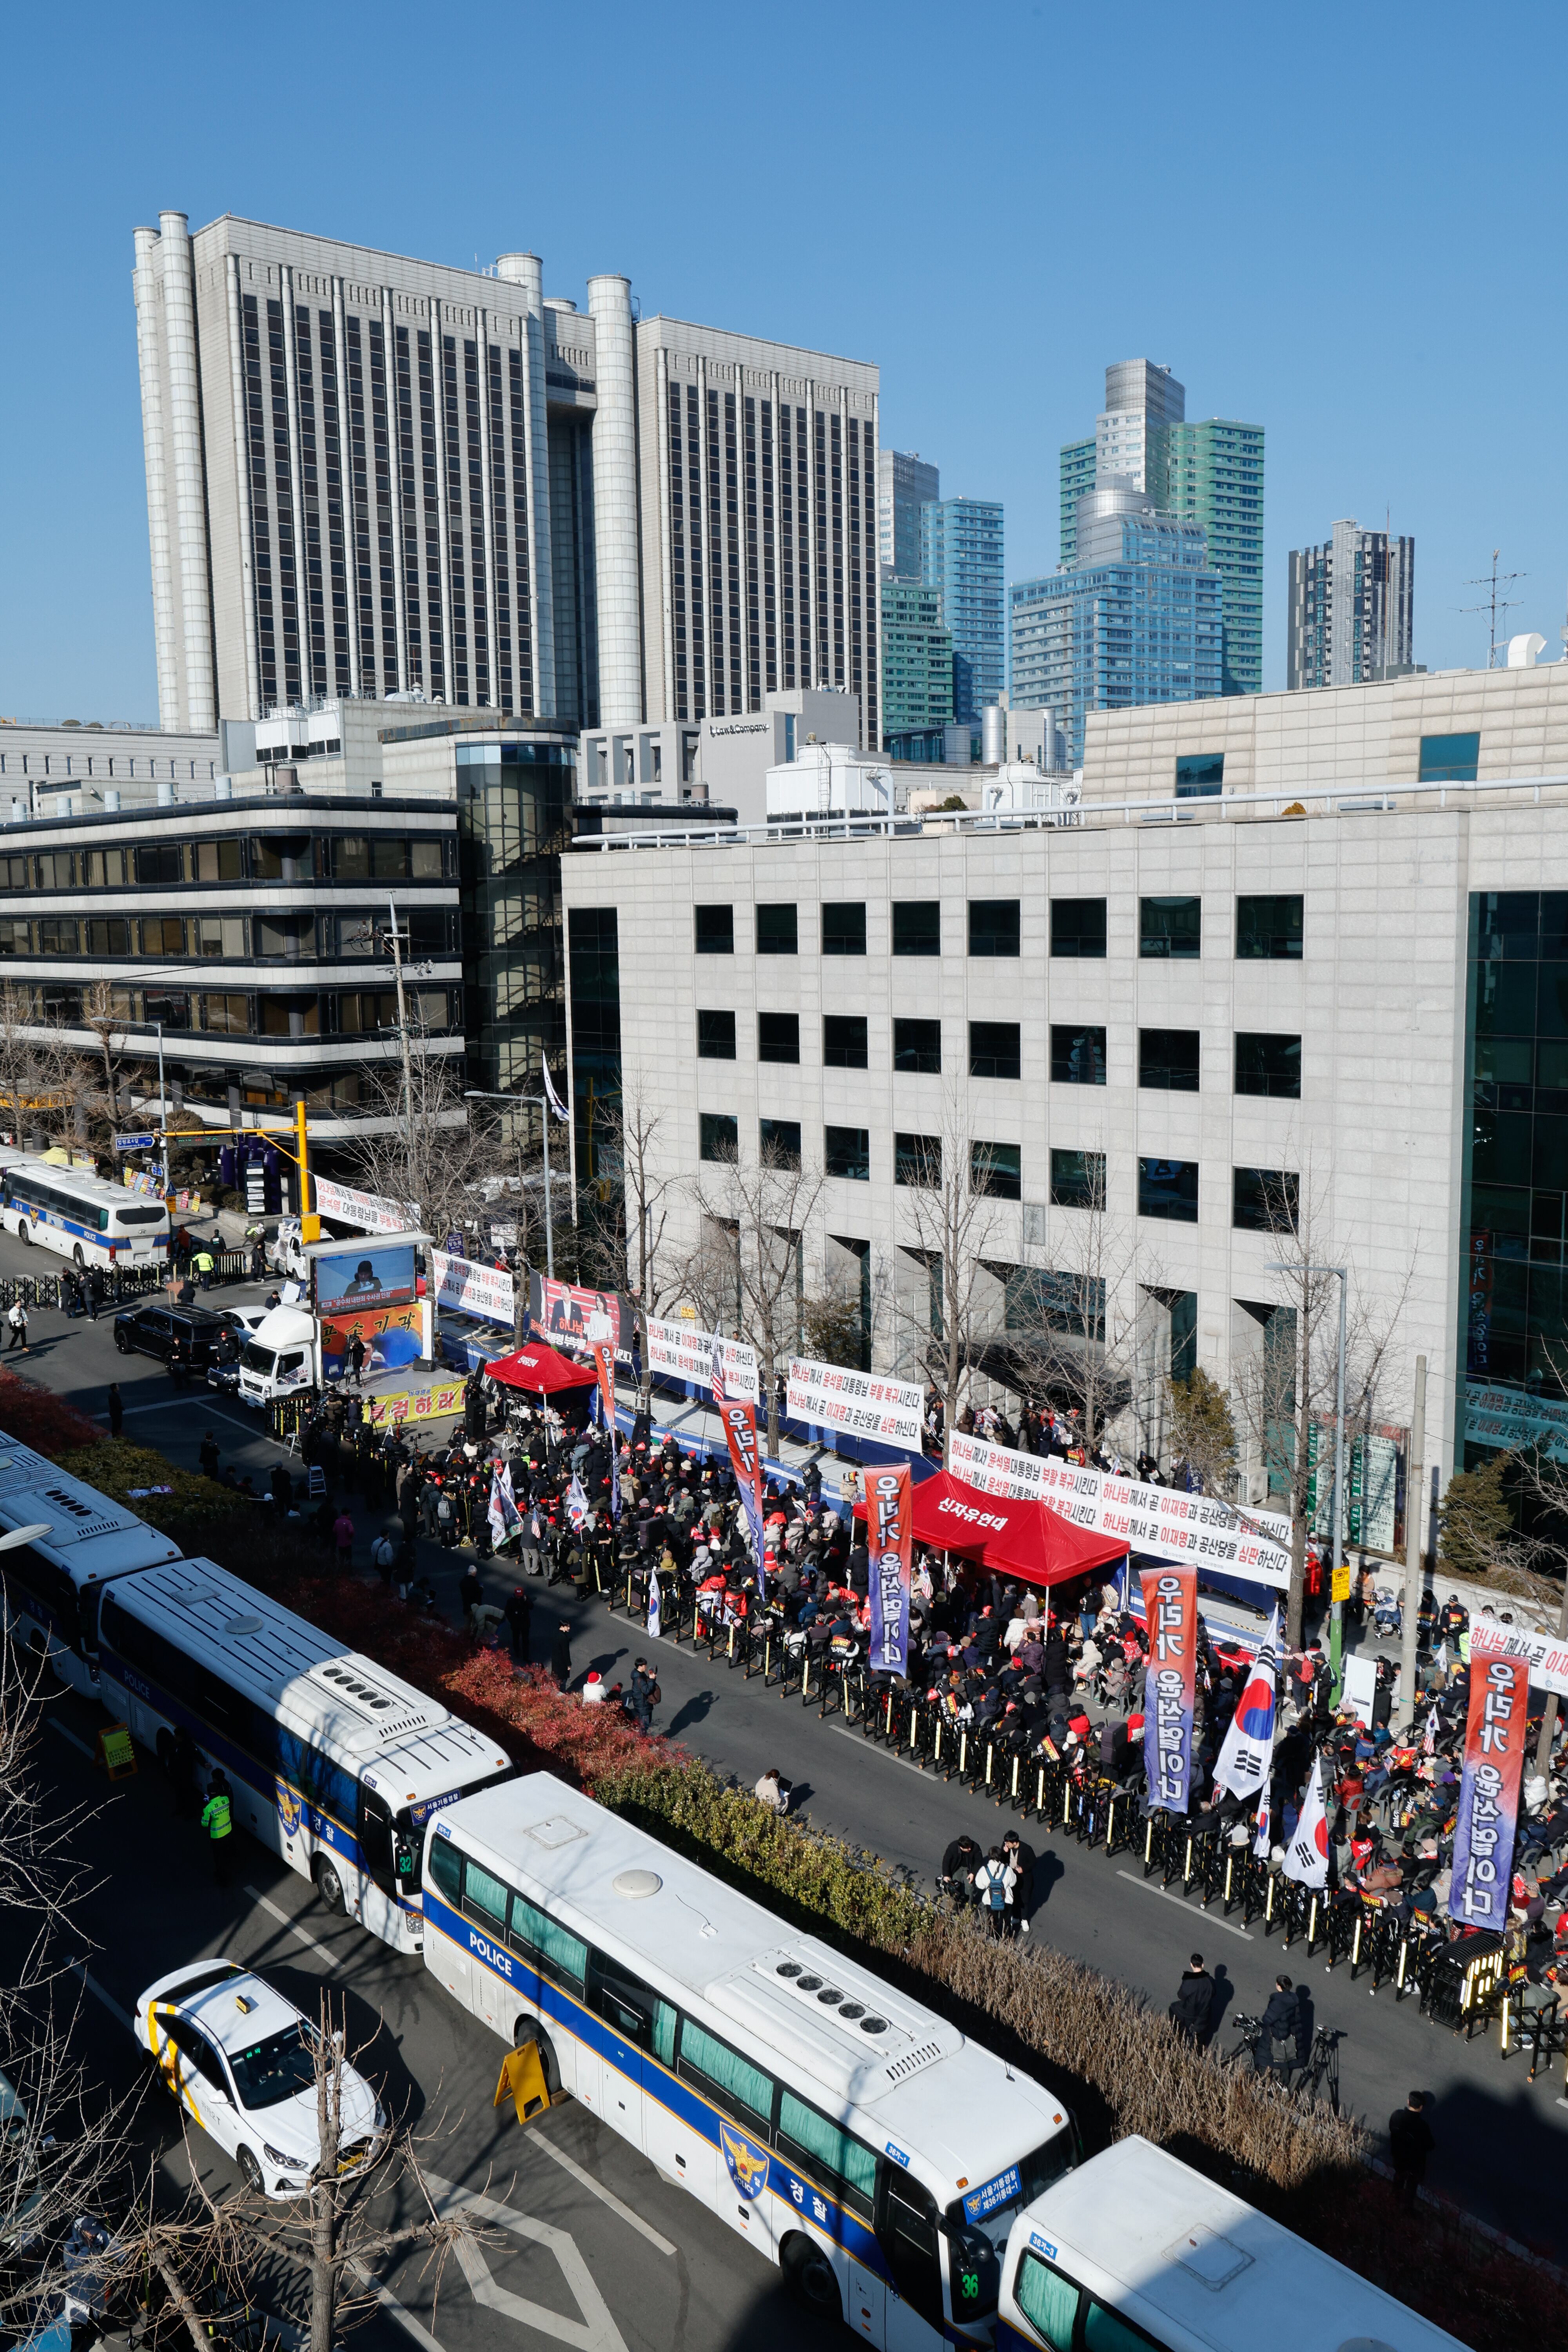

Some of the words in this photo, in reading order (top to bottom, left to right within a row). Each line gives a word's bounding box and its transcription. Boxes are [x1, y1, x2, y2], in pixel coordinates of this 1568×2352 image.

[716, 724, 767, 735] Law&Company
[319, 1195, 340, 1212] 윤석열
[343, 1202, 378, 1223] 대통령님을
[84, 1230, 96, 1241] POLICE
[481, 1272, 490, 1285] 부활
[477, 1290, 492, 1306] 공산당을
[493, 1295, 513, 1312] 심판하신다
[559, 1317, 597, 1338] 하나님께서
[564, 1334, 587, 1350] 부부를
[649, 1323, 673, 1342] 하나님께서
[675, 1332, 680, 1345] 곧
[682, 1334, 702, 1352] 이재명과
[726, 1347, 753, 1367] 심판하신다
[650, 1345, 677, 1366] 하나님께서
[678, 1354, 712, 1376] 윤석열대통령
[728, 1370, 755, 1391] 복귀시킨다
[791, 1363, 822, 1385] 하나님께서
[823, 1372, 869, 1397] 윤석열대통령님
[869, 1383, 884, 1400] 부활
[885, 1386, 920, 1409] 복귀시킨다
[788, 1390, 818, 1412] 하나님께서
[818, 1400, 826, 1415] 곧
[826, 1402, 853, 1423] 이재명과
[853, 1409, 881, 1430] 공산당을
[881, 1417, 917, 1438] 심판하신다
[952, 1439, 987, 1466] 하나님께서
[988, 1452, 1040, 1482] 윤석열대통령님
[1042, 1467, 1058, 1486] 부활
[1058, 1472, 1098, 1497] 복귀시킨다
[937, 1497, 1008, 1531] 신자유연대
[1056, 1498, 1096, 1525] 복귀시킨다
[1103, 1482, 1148, 1510] 하나님께서
[1149, 1494, 1159, 1512] 곧
[1161, 1497, 1197, 1521] 이재명과
[1200, 1506, 1238, 1530] 공산당을
[1102, 1512, 1148, 1538] 하나님께서
[1149, 1524, 1158, 1541] 곧
[1160, 1526, 1197, 1550] 이재명과
[1199, 1536, 1238, 1560] 공산당을
[1239, 1545, 1288, 1573] 심판하신다
[1530, 1646, 1547, 1668] 곧
[124, 1670, 151, 1699] POLICE
[214, 1808, 230, 1817] POLICE
[426, 1793, 458, 1810] 서울기동경찰
[282, 1819, 295, 1832] POLICE
[313, 1814, 334, 1842] 경찰
[399, 1856, 412, 1873] 32
[470, 1931, 512, 1977] POLICE
[201, 2100, 217, 2122] 카카오
[728, 2155, 734, 2166] 경
[888, 2145, 907, 2164] 36기-1
[733, 2174, 754, 2195] POLICE
[754, 2176, 761, 2188] 찰
[981, 2169, 1016, 2200] 서울기동경찰
[790, 2178, 828, 2222] 경찰
[983, 2183, 1018, 2211] 제36기동대-1
[1033, 2236, 1054, 2256] 36기-3
[962, 2274, 978, 2298] 36
